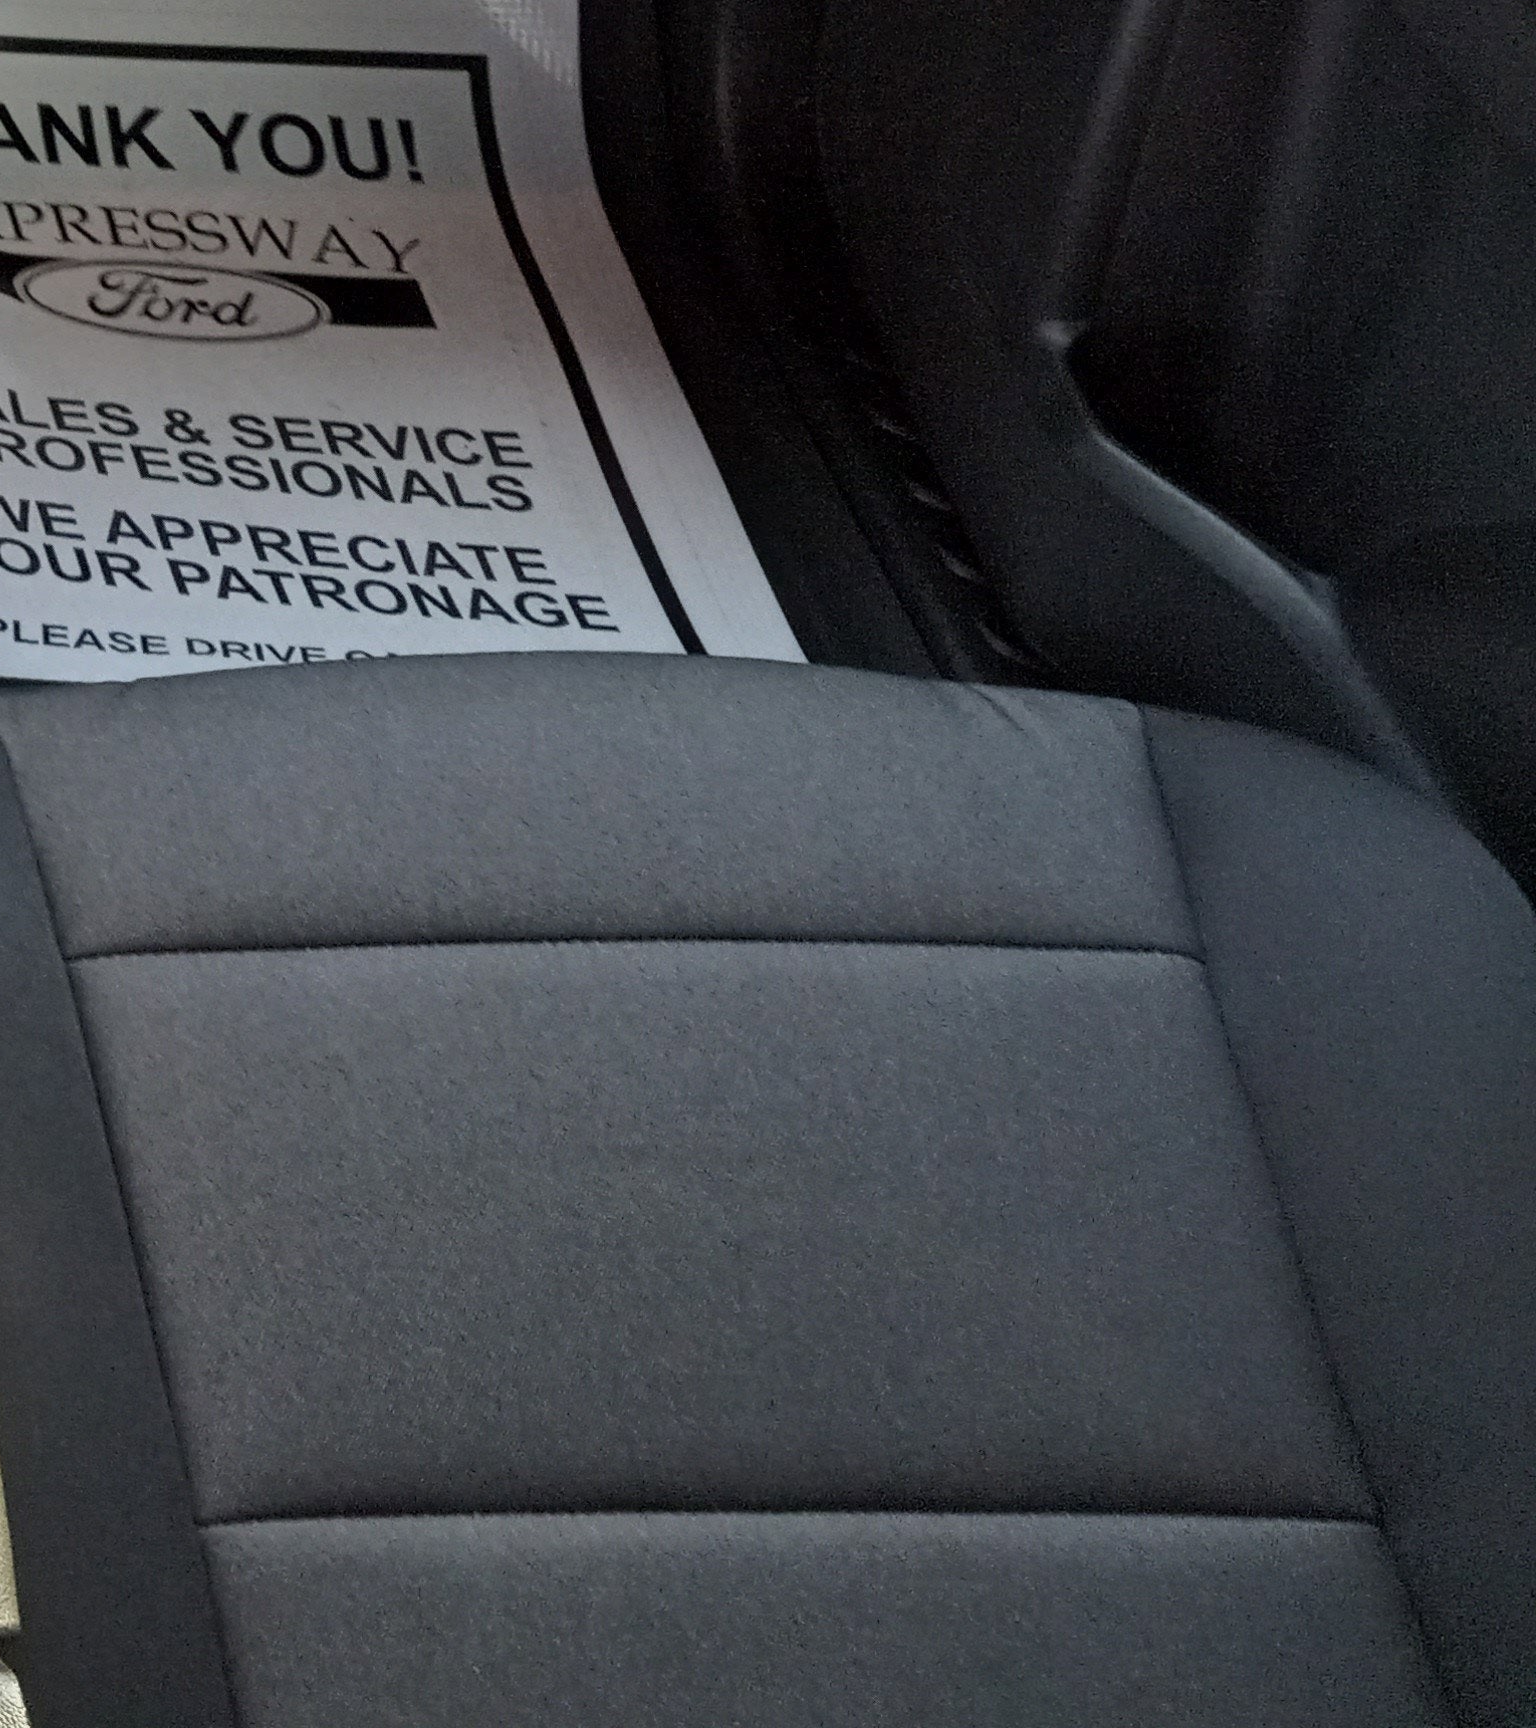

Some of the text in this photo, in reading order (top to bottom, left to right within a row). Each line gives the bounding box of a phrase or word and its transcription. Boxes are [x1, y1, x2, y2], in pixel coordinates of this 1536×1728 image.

[189, 108, 426, 184] YOU!
[86, 272, 258, 328] Ford
[164, 408, 212, 445] &
[229, 414, 534, 470] SERVICE
[106, 510, 558, 586] APPRECIATE
[170, 559, 622, 633] PATRONAGE
[185, 637, 327, 664] DRIVE
